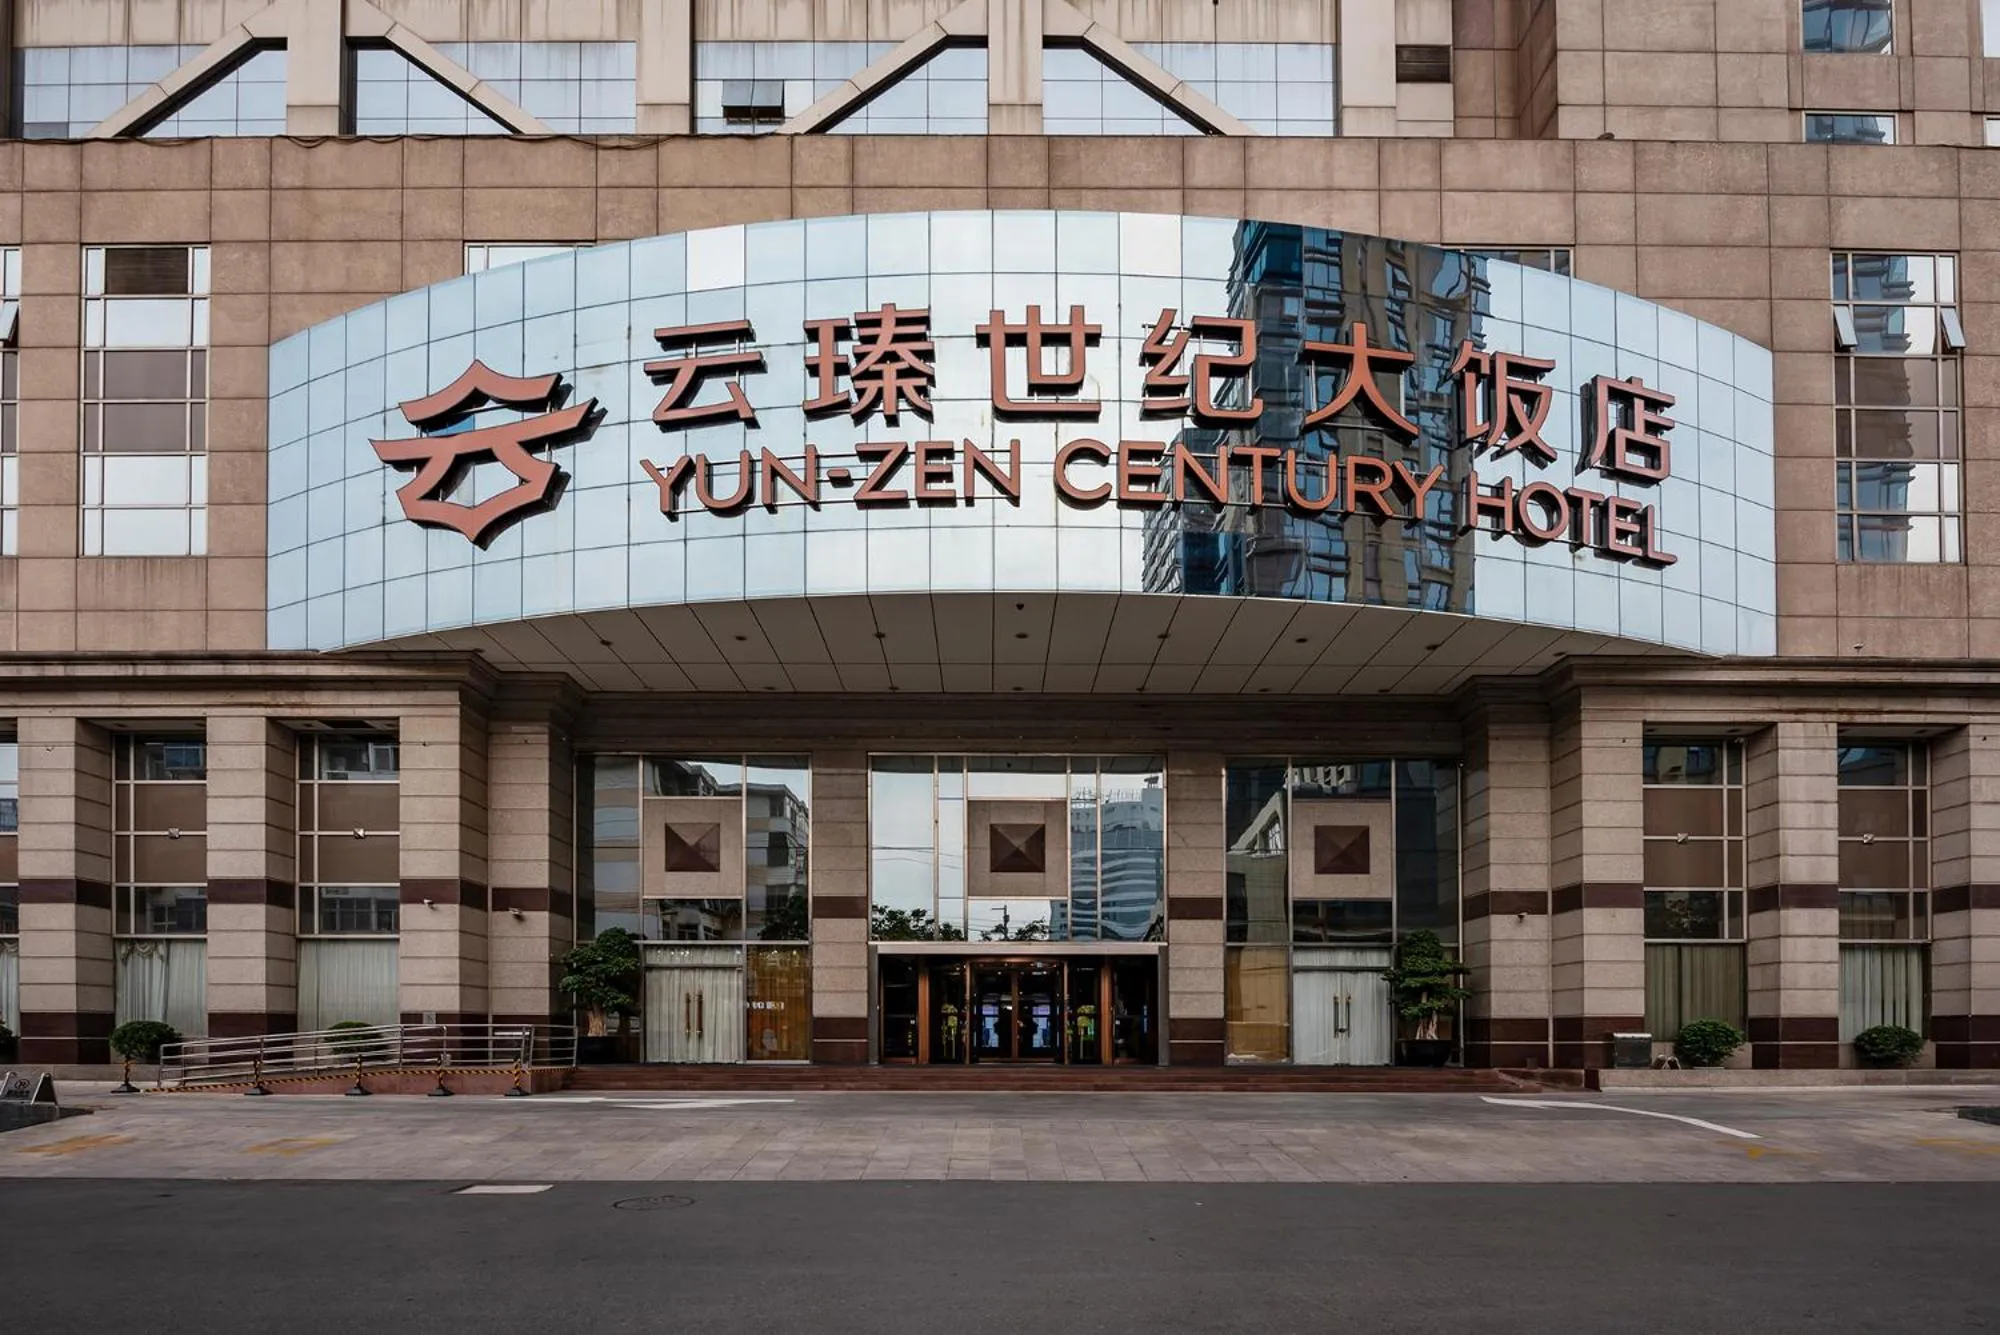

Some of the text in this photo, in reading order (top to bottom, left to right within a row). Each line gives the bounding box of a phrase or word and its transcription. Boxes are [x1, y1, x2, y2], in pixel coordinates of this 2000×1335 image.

[643, 302, 1676, 485] 云瑧世纪大饭店
[640, 438, 1678, 568] YUN-ZEN CENTURY HOTEL
